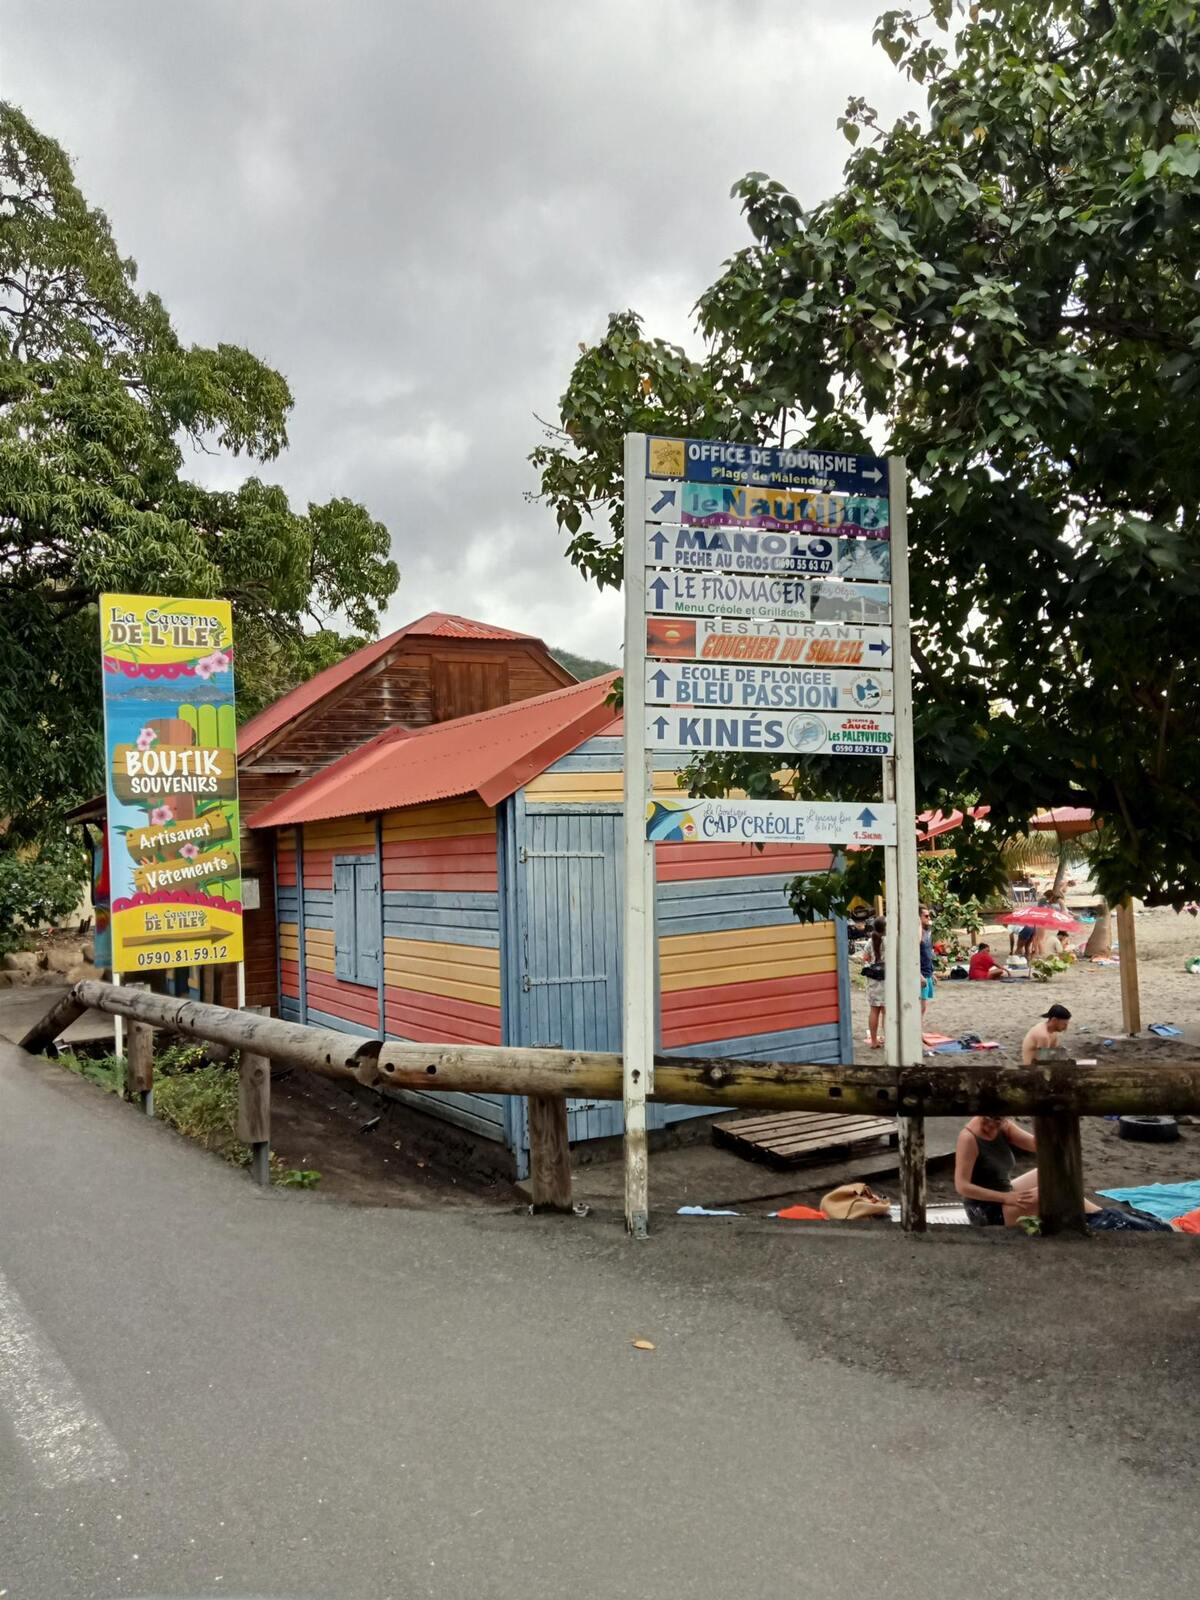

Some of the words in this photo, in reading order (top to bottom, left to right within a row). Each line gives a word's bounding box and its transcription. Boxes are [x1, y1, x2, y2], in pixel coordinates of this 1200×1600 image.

[688, 444, 746, 464] OFFICE
[750, 449, 772, 466] DE
[776, 451, 857, 474] TOURISME
[711, 467, 748, 481] Plage
[752, 470, 768, 480] de
[771, 472, 836, 487] Malendure
[692, 493, 719, 512] le
[675, 529, 833, 558] MANOLO
[675, 550, 712, 567] PECHE
[716, 554, 732, 568] AU
[736, 555, 769, 571] GROS
[796, 559, 807, 570] 55
[808, 560, 819, 571] 63
[820, 561, 831, 572] 47
[674, 575, 697, 599] LE
[701, 577, 807, 605] FROMAGER
[111, 607, 136, 624] La
[145, 608, 218, 628] Caverne
[674, 601, 704, 612] Menu
[707, 603, 742, 615] Créole
[745, 606, 756, 615] et
[758, 606, 806, 618] Grillades
[109, 622, 142, 644] DE
[704, 621, 865, 640] RESTAURANT
[701, 633, 780, 661] COUCHER
[777, 637, 808, 661] DU
[804, 638, 865, 665] SOLEIL
[681, 666, 730, 682] ECOLE
[735, 669, 756, 683] DE
[761, 670, 832, 686] PLONGEE
[676, 680, 733, 705] BLEU
[742, 683, 839, 709] PASSION
[678, 712, 785, 748] KINÉS
[828, 730, 840, 742] Les
[841, 723, 880, 731] GAUCHE
[835, 745, 853, 753] 0590
[876, 746, 885, 754] 43
[125, 749, 223, 777] BOUTIK
[130, 776, 218, 794] SOUVENIRS
[703, 815, 738, 838] CAP
[741, 811, 805, 838] CRÉOLE
[140, 822, 211, 850] Artisanat
[145, 856, 229, 889] Vêtements
[145, 911, 159, 921] La
[163, 909, 205, 920] Caverne
[145, 919, 162, 931] DE
[137, 945, 227, 966] 0590.81.59.12
